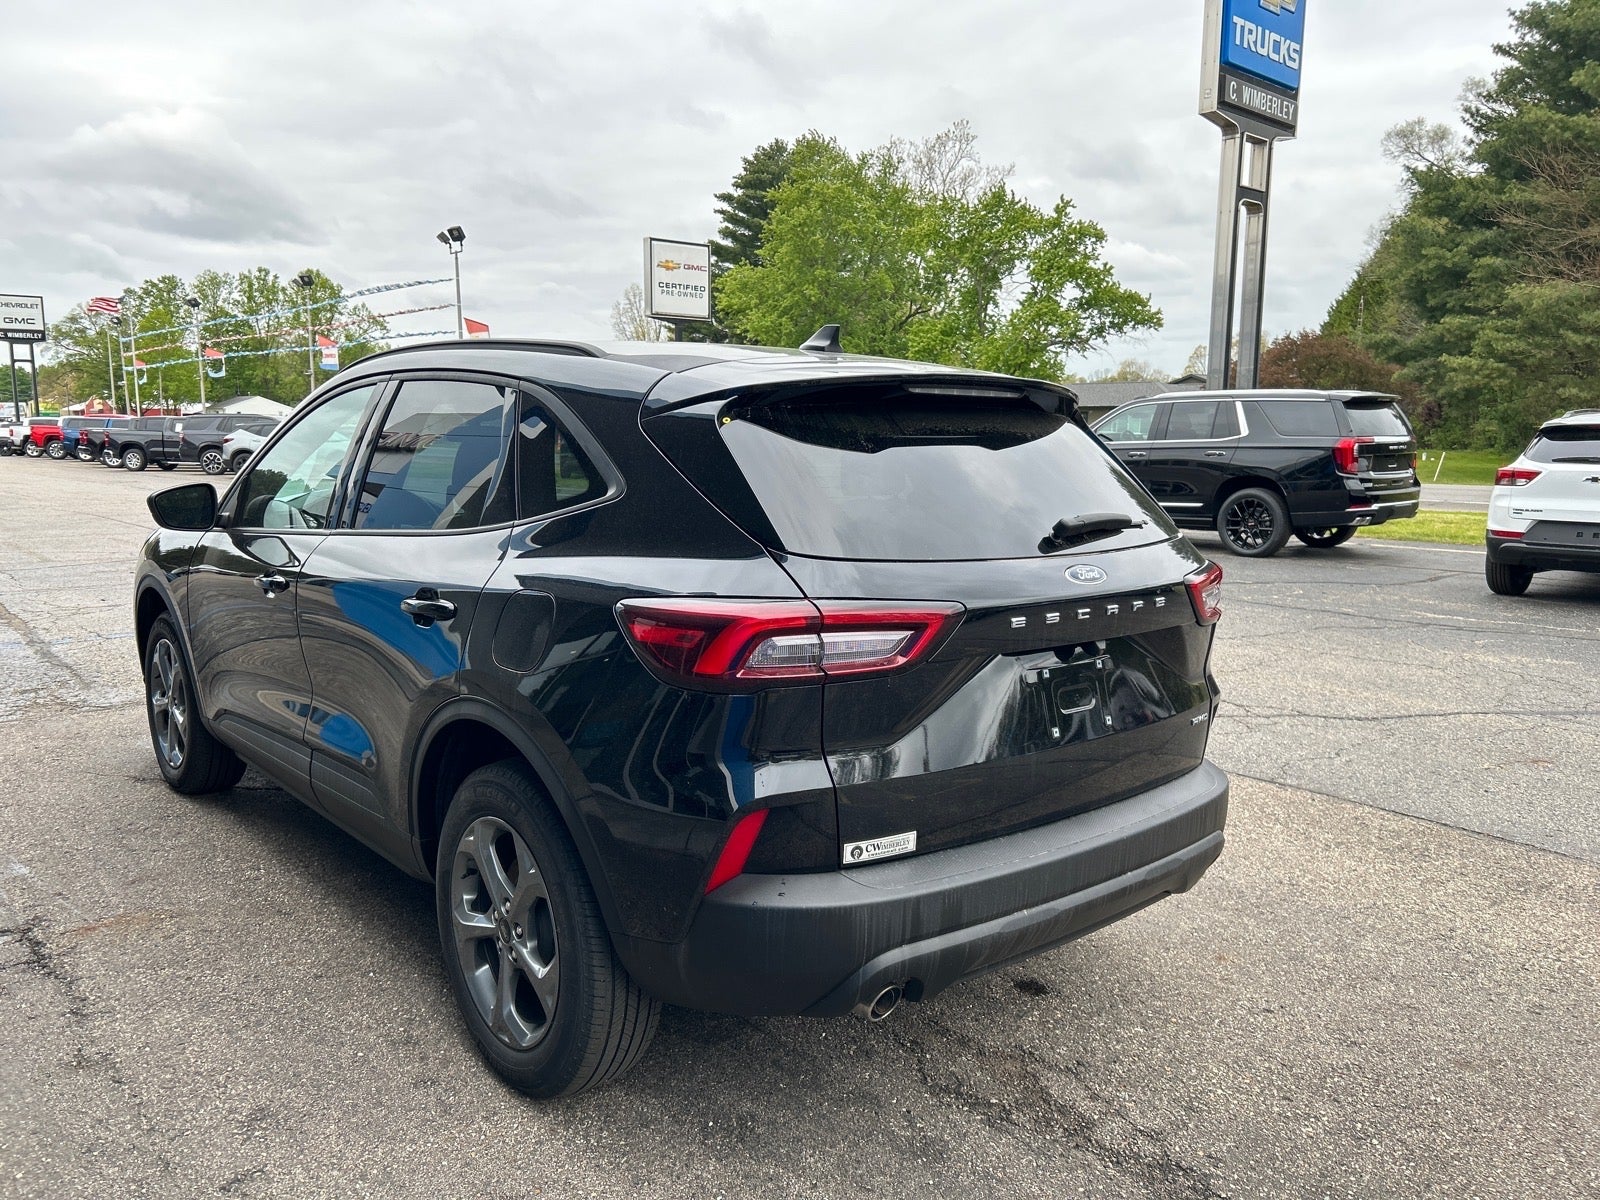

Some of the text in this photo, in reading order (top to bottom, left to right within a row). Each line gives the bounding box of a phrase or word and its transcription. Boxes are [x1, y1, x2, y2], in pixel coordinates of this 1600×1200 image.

[1233, 15, 1300, 70] TRUCKS
[1229, 81, 1295, 121] C. WIMBERLEY
[683, 264, 707, 272] GMC
[658, 282, 706, 292] CERTIFIED
[661, 289, 704, 299] PRE-OWNED
[1076, 567, 1101, 580] Ford
[1011, 597, 1166, 628] ESCAPE
